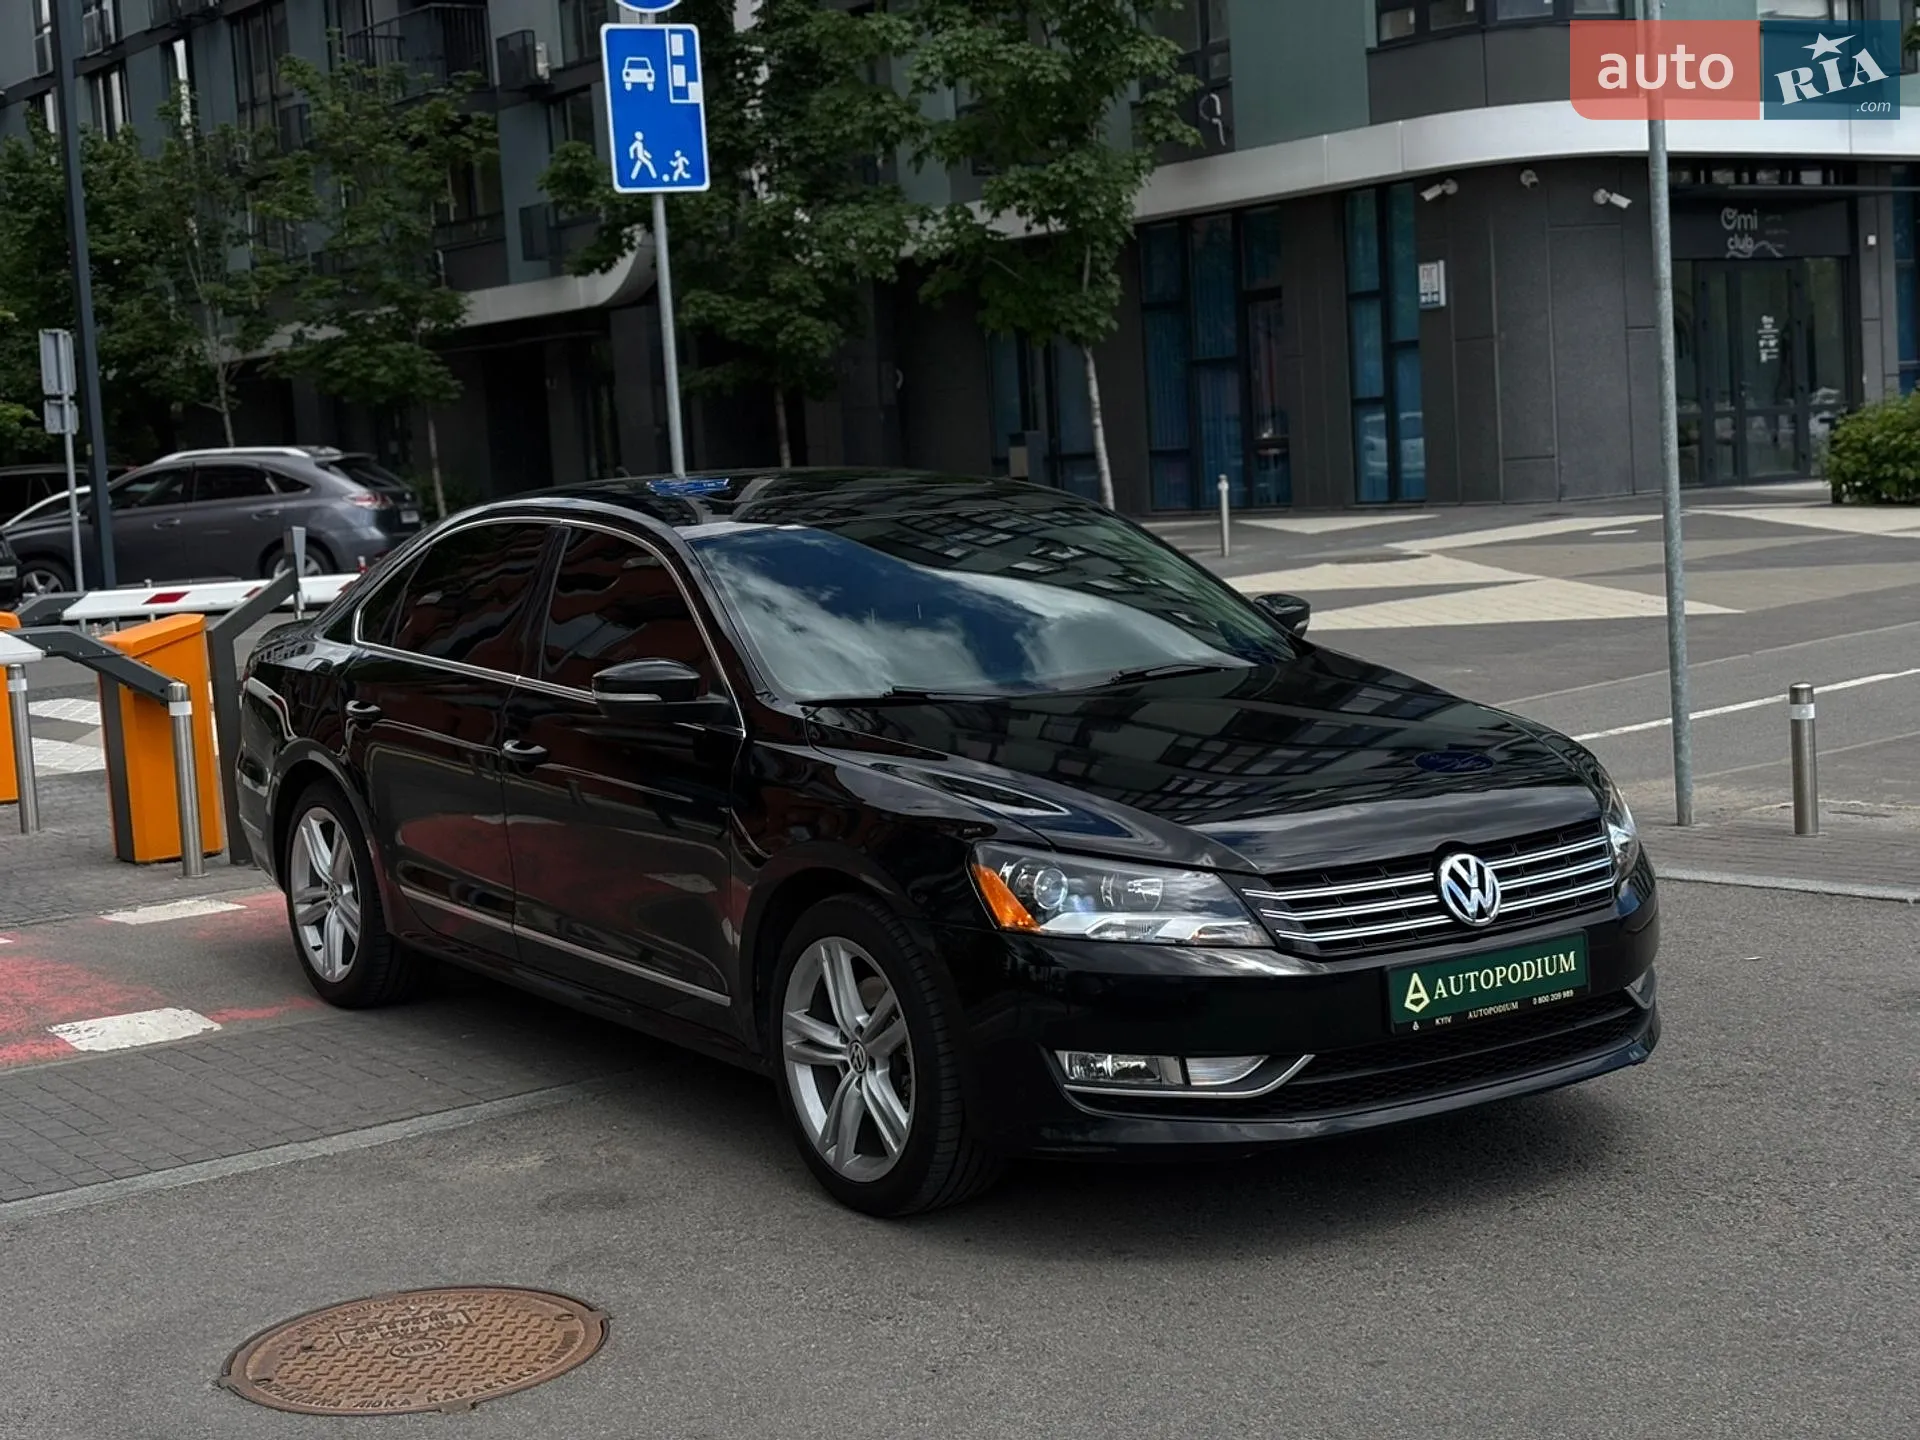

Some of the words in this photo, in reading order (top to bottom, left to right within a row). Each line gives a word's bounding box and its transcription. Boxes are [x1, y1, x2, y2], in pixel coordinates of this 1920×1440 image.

[1433, 951, 1576, 1000] AUTOPODIUM
[1434, 1015, 1452, 1026] KYIV
[1467, 1001, 1519, 1020] AUTOPODIUM
